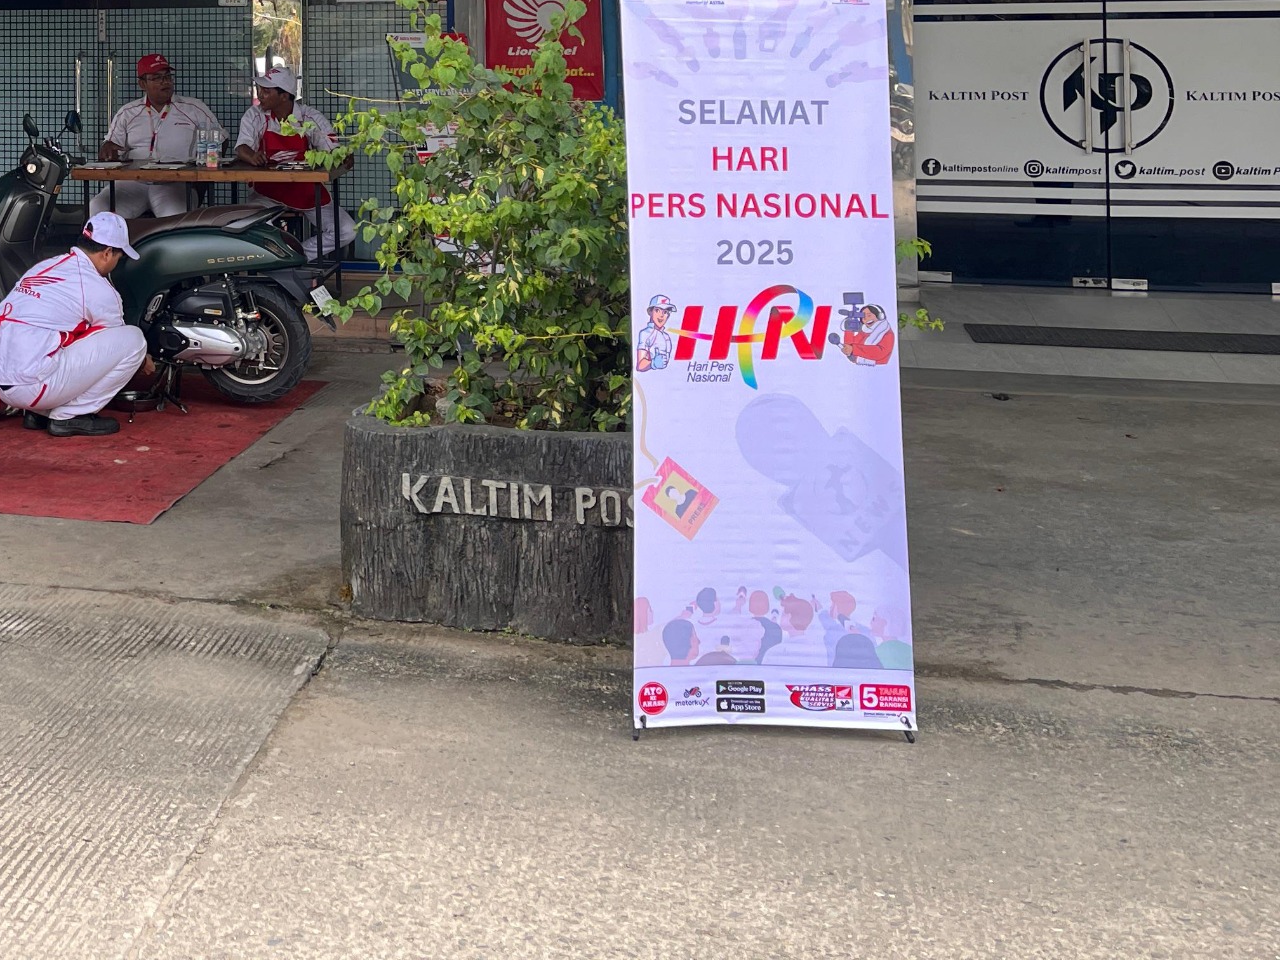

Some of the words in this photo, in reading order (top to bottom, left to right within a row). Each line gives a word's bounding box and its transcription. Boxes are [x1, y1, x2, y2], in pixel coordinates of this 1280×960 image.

[928, 90, 986, 101] KALTIM
[991, 90, 1030, 101] POST
[1186, 90, 1246, 101] KALTIM
[678, 99, 829, 125] SELAMAT
[712, 146, 788, 172] HARI
[942, 164, 1019, 174] kaltimpostonline
[1045, 166, 1102, 177] kaltimpost
[1138, 166, 1206, 178] kaltim_post
[1236, 166, 1271, 176] kaltim
[632, 193, 706, 218] PERS
[716, 193, 890, 218] NASIONAL
[716, 240, 794, 266] 2025
[207, 254, 266, 264] SCOOPY
[14, 286, 41, 299] HONDA
[687, 362, 708, 372] Hari
[710, 362, 734, 372] Pers
[686, 372, 732, 383] Nasional
[402, 472, 553, 522] KALTIM
[644, 687, 662, 696] AYO
[862, 687, 878, 708] 5
